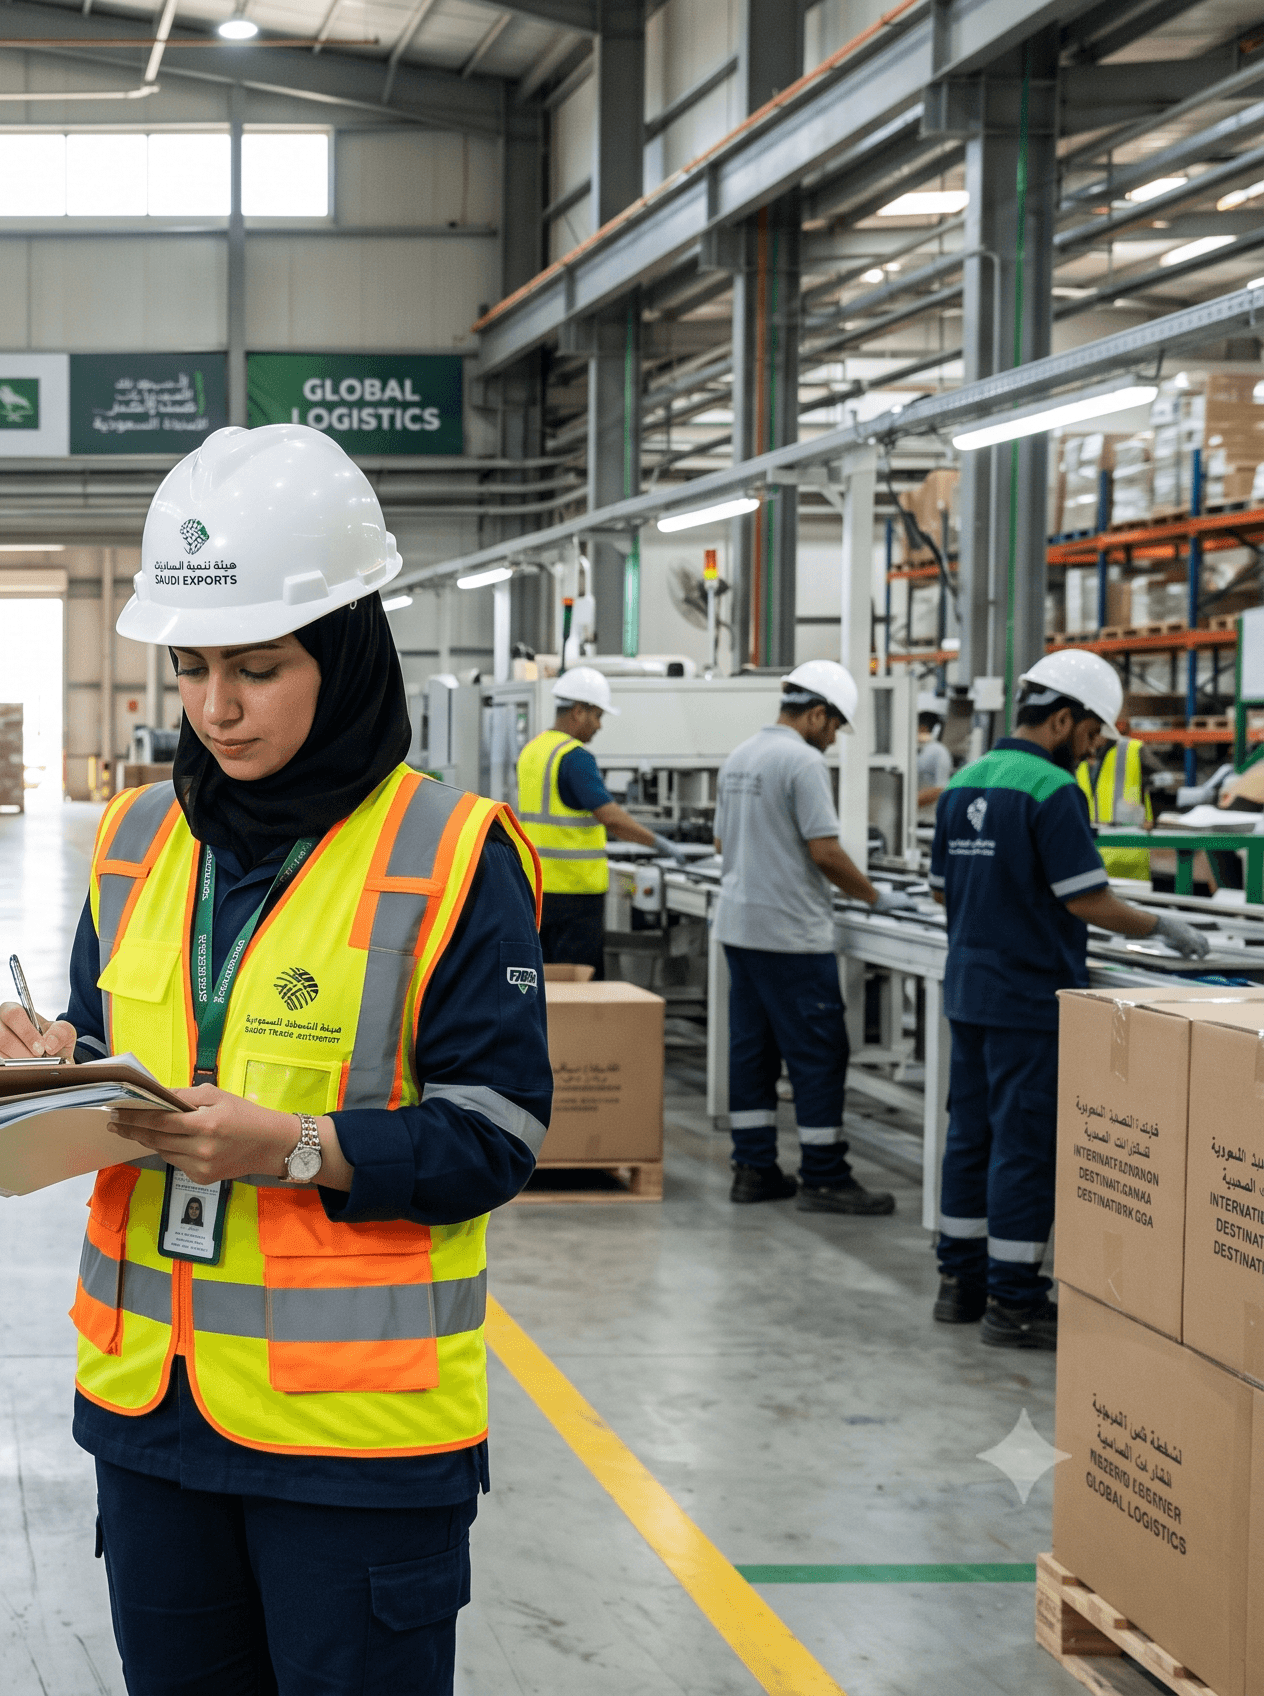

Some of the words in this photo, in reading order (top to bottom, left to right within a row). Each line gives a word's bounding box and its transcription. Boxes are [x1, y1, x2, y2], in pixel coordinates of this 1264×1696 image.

[302, 377, 422, 402] GLOBAL
[154, 574, 180, 586] SAUDI
[182, 574, 238, 586] EXPORTS
[1086, 1471, 1126, 1513] GLOBAL
[1127, 1500, 1186, 1556] LOGISTICS
